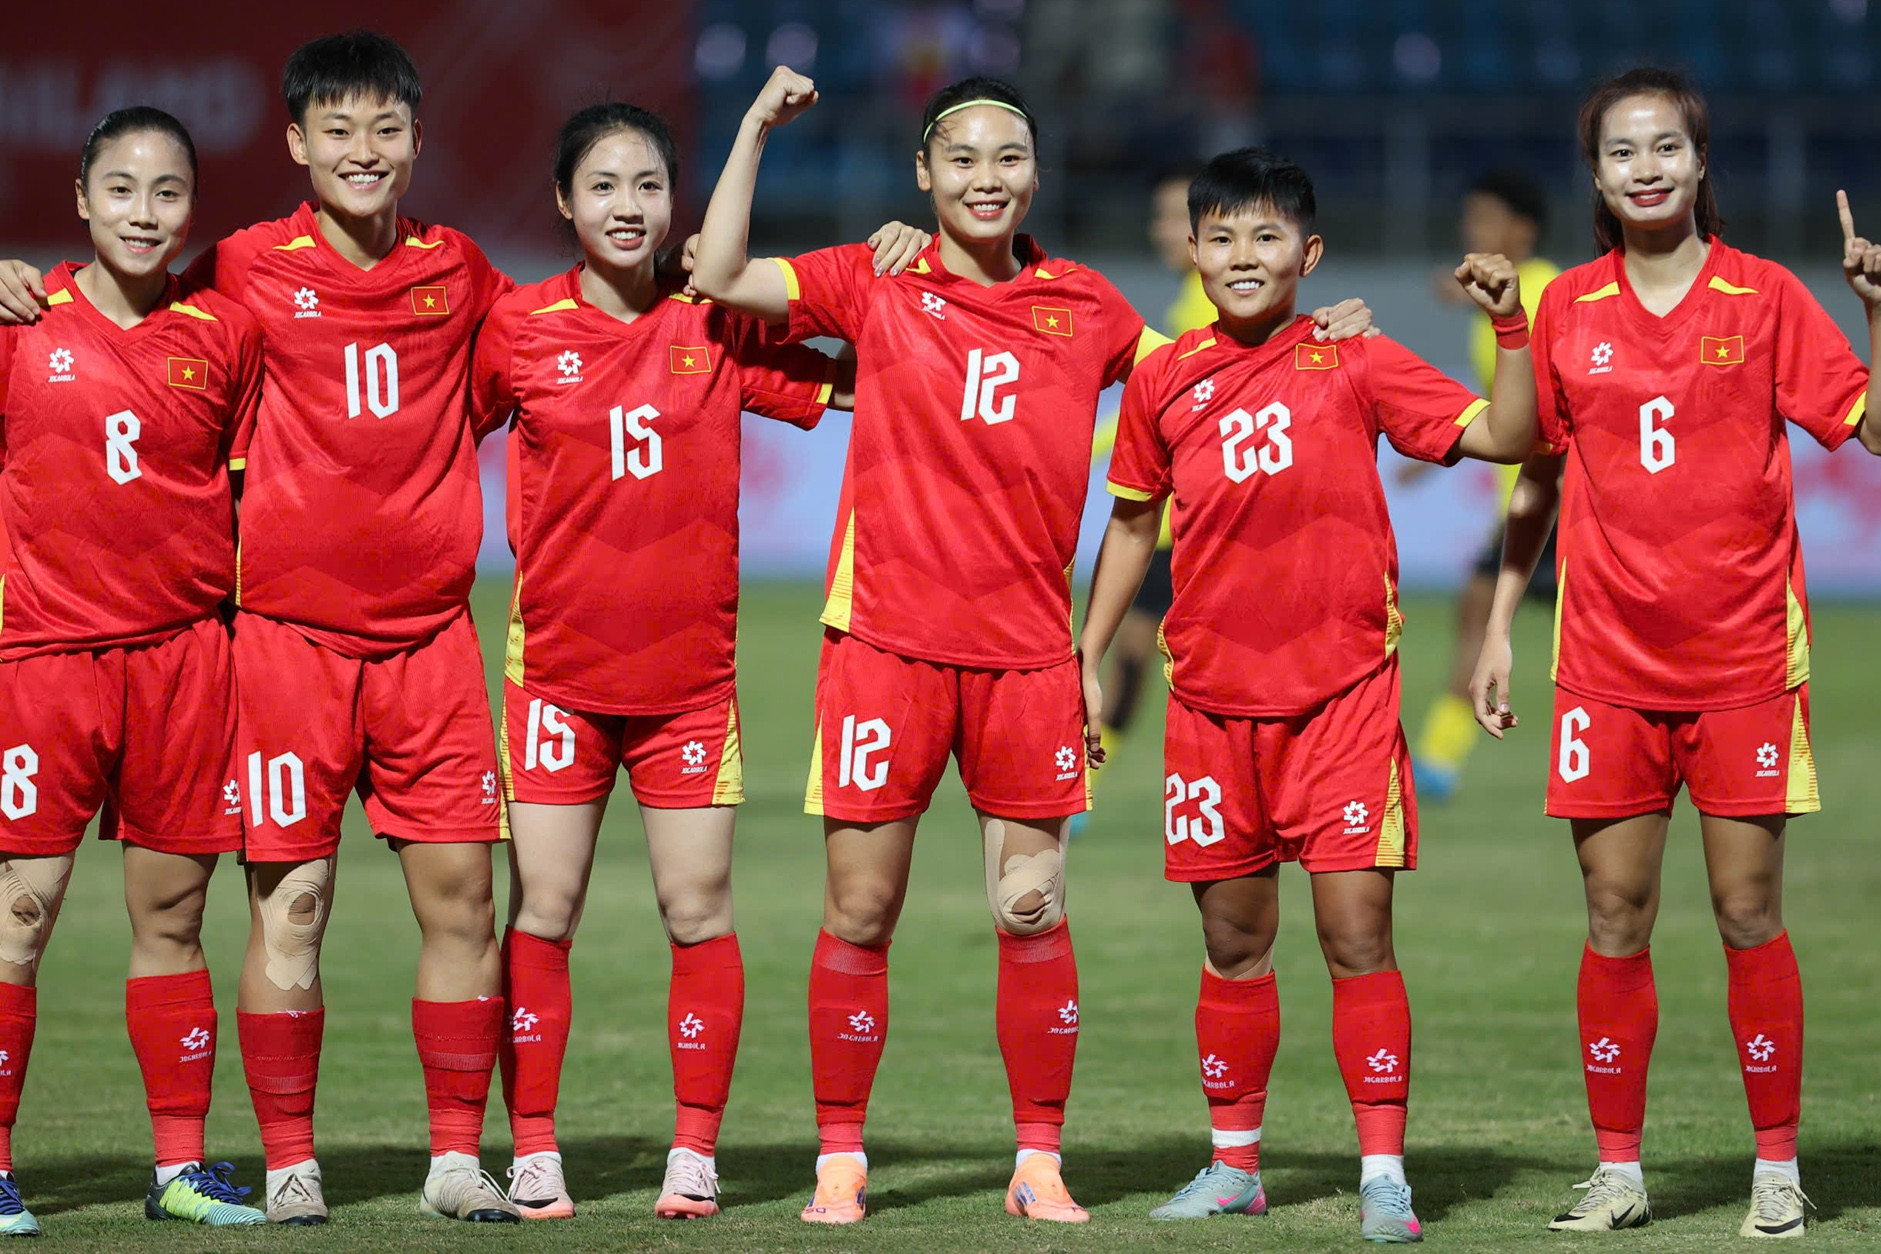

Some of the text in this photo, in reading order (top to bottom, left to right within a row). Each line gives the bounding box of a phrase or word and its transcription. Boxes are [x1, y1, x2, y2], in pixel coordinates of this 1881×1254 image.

[344, 342, 398, 419] 10
[961, 348, 1020, 425] 12
[106, 410, 142, 485] 8
[610, 403, 662, 480] 15
[1219, 401, 1293, 483] 23
[1640, 396, 1675, 474] 6
[525, 699, 575, 772] 15
[839, 715, 891, 791] 12
[1559, 706, 1590, 783] 6
[0, 744, 38, 820] 8
[248, 751, 306, 827] 10
[1166, 773, 1225, 847] 23
